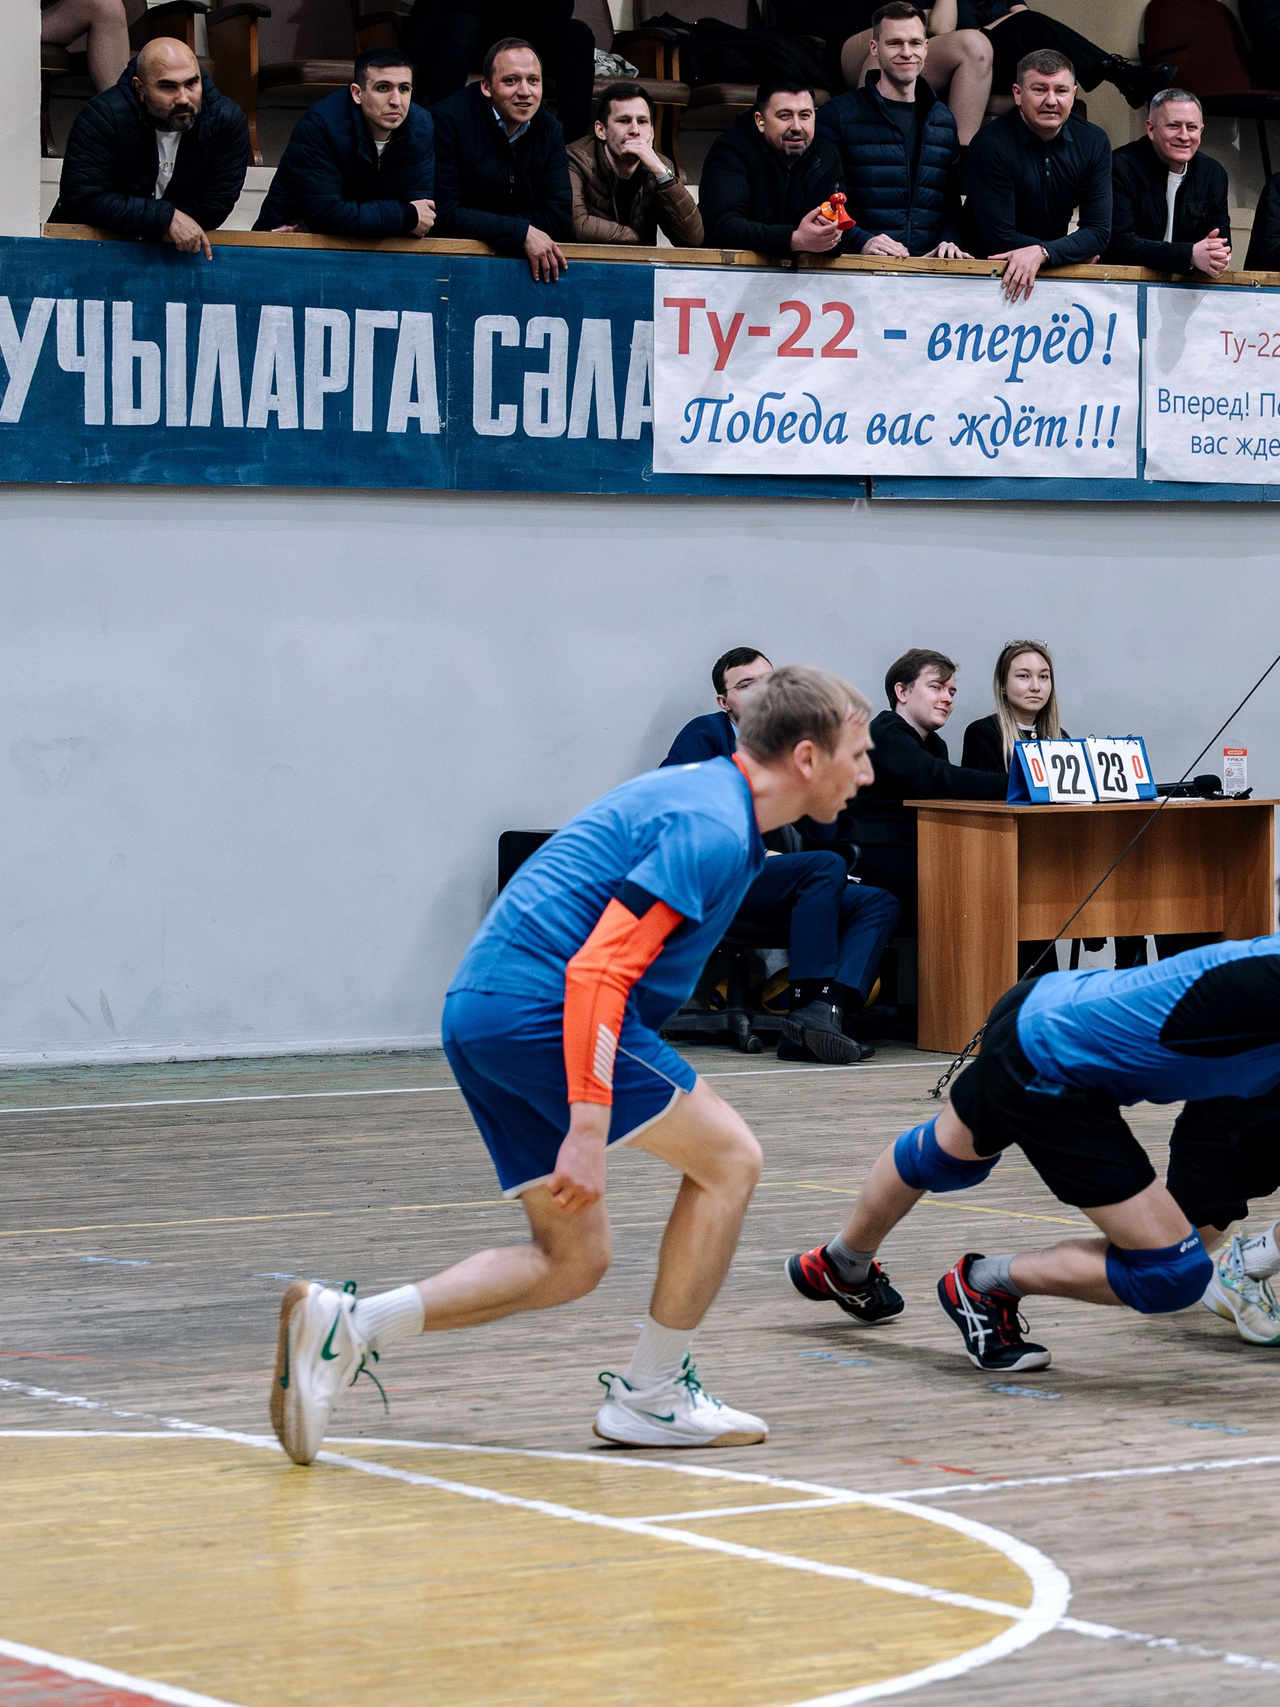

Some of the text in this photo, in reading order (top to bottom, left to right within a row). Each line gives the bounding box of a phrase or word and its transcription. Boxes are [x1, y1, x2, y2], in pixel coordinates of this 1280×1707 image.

[0, 295, 441, 434] УЧЫЛАРГА
[663, 297, 858, 371] Ту-22
[927, 303, 1117, 383] вперёд!
[680, 391, 1121, 459] Победа вас ждёт!!!
[1158, 388, 1250, 422] Вперед!
[1191, 435, 1228, 455] вас
[1031, 751, 1144, 794] 0 22 23 0
